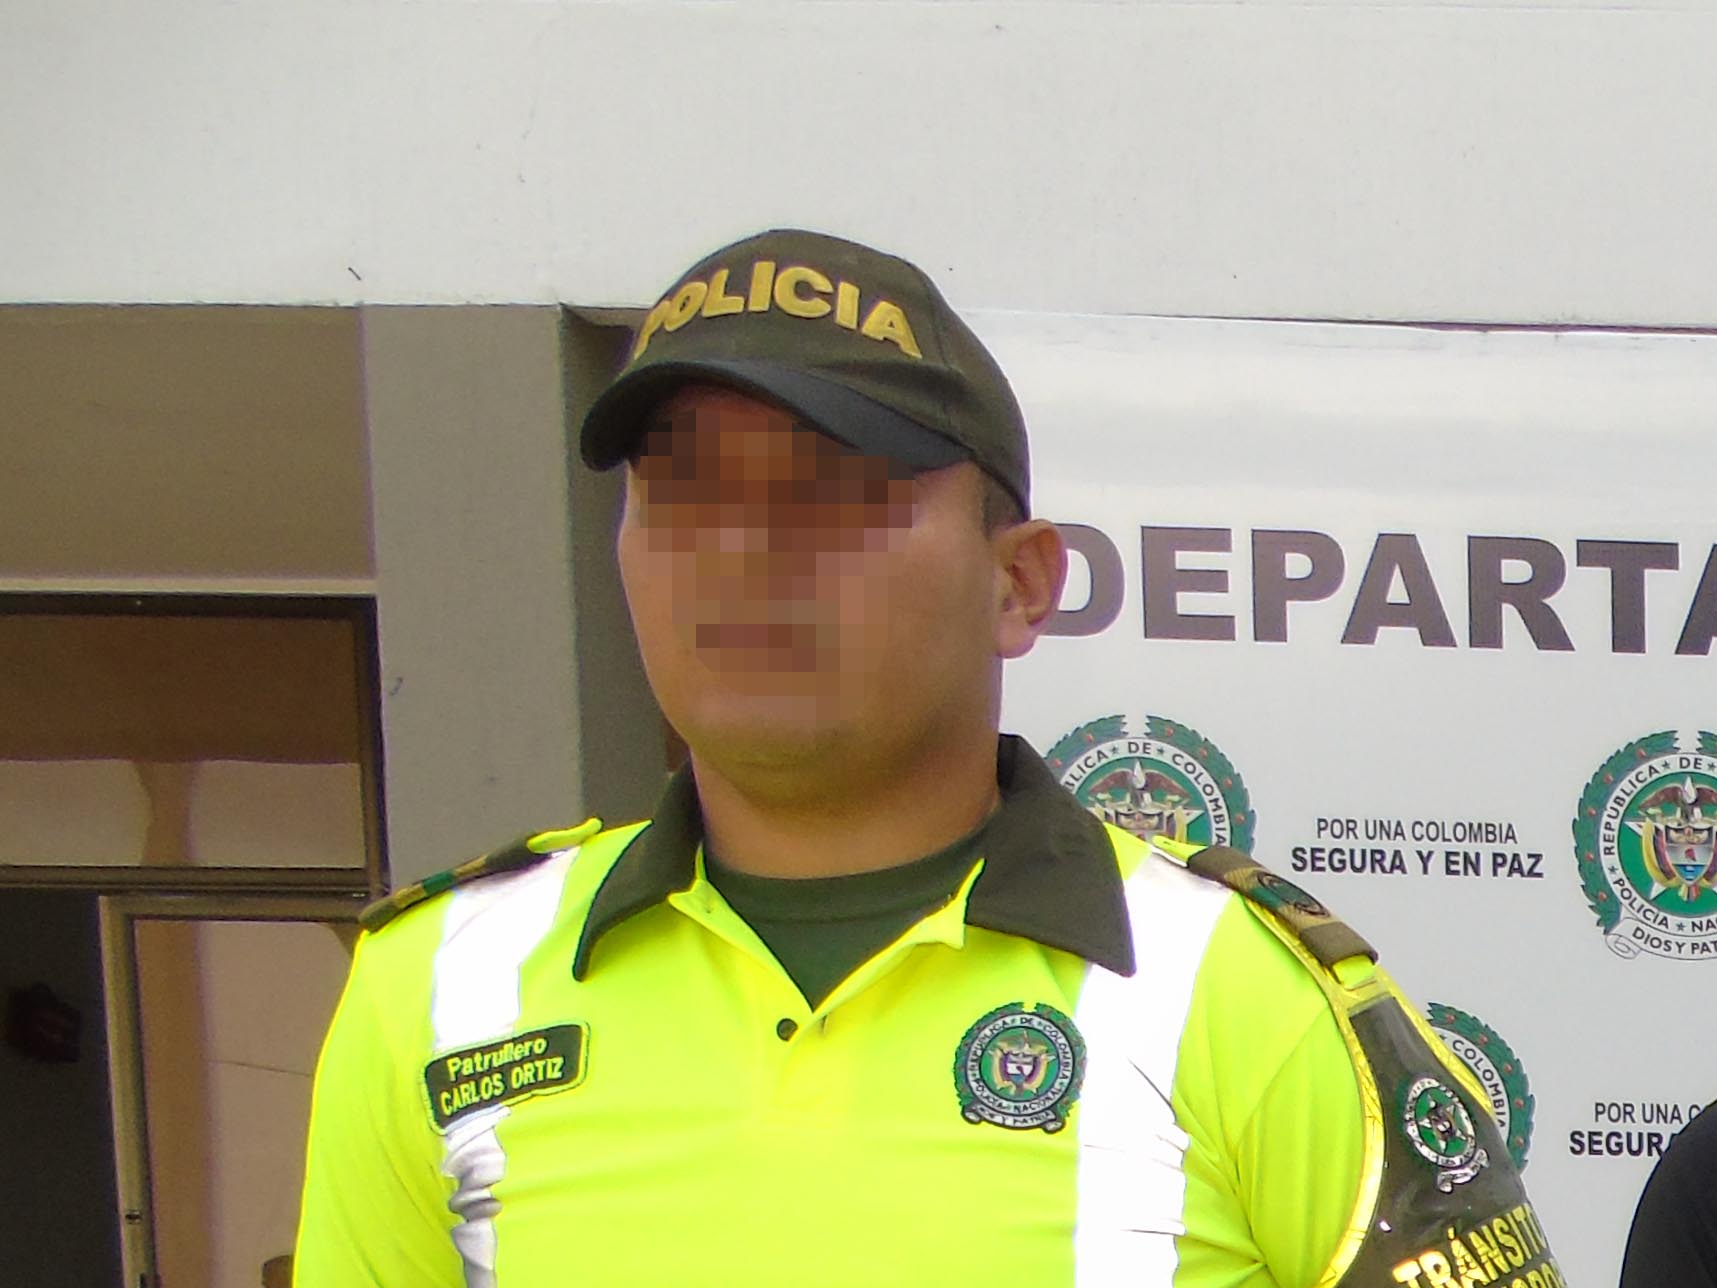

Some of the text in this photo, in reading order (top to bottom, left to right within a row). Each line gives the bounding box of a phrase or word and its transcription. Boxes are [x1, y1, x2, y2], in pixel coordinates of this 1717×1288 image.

[633, 261, 922, 360] POLICIA
[1679, 756, 1702, 770] DE
[1128, 741, 1152, 755] DE
[1171, 753, 1227, 846] COLOMBIA
[1316, 817, 1518, 844] POR UNA COLOMBIA
[1291, 847, 1545, 878] SEGURA Y EN PAZ
[1632, 926, 1673, 954] DIOS
[1672, 939, 1686, 954] Y
[446, 1036, 547, 1081] Patrullero
[440, 1056, 565, 1116] CARLOS ORTIZ
[1594, 1102, 1636, 1124] POR
[1642, 1103, 1683, 1125] UNA
[1569, 1130, 1664, 1157] SEGUR
